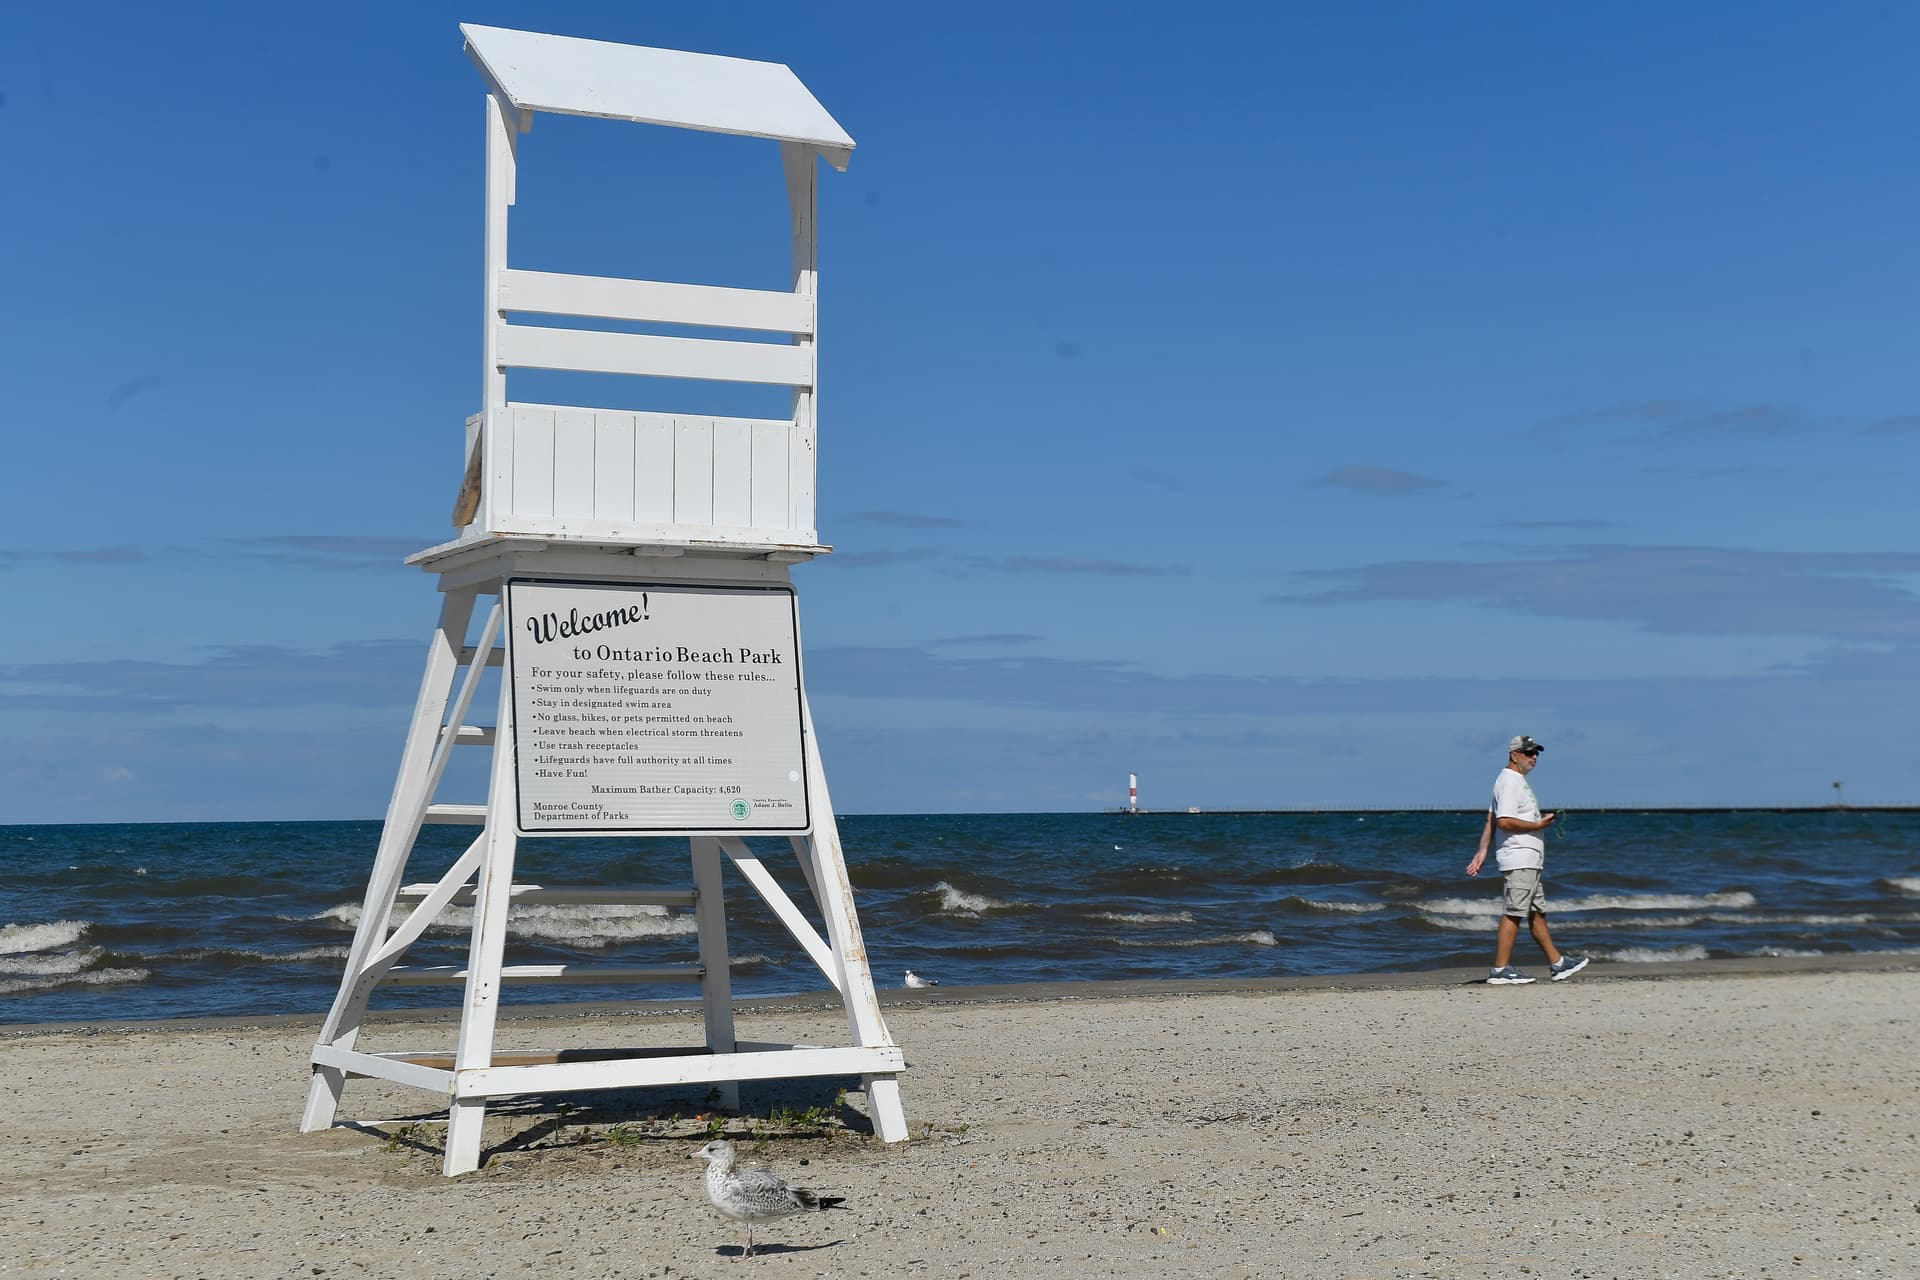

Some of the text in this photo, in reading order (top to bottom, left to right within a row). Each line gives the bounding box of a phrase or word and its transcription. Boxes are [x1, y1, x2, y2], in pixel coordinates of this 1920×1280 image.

[527, 592, 649, 644] Welcome!
[573, 645, 782, 663] to Ontario Beach Park
[532, 667, 775, 681] For your safety, please follow these rules...
[537, 684, 562, 694] Swim
[564, 685, 584, 695] only
[587, 685, 611, 694] when
[614, 685, 659, 695] lifeguards
[678, 687, 691, 695] on
[692, 686, 712, 696] duty
[537, 698, 558, 708] Stay
[560, 699, 570, 708] in
[572, 699, 622, 709] designated
[625, 700, 649, 709] swim
[538, 713, 550, 722] No
[553, 713, 579, 723] glass,
[581, 713, 608, 723] bikes,
[624, 715, 643, 724] pets
[645, 714, 690, 725] permitted
[693, 717, 704, 725] on
[707, 715, 732, 724] beach
[538, 727, 743, 737] Leave beach when electrical storm threatens
[539, 741, 639, 751] Use trash receptacles
[540, 755, 590, 765] Lifeguards
[593, 756, 614, 764] have
[618, 756, 633, 765] full
[636, 756, 679, 766] authority
[694, 756, 706, 765] all
[708, 756, 732, 765] times
[539, 769, 587, 778] Have Fun!
[592, 785, 740, 795] Maximum Bather Capacity: 4,620
[534, 802, 603, 813] Monroe County
[534, 811, 629, 821] Department of Parks
